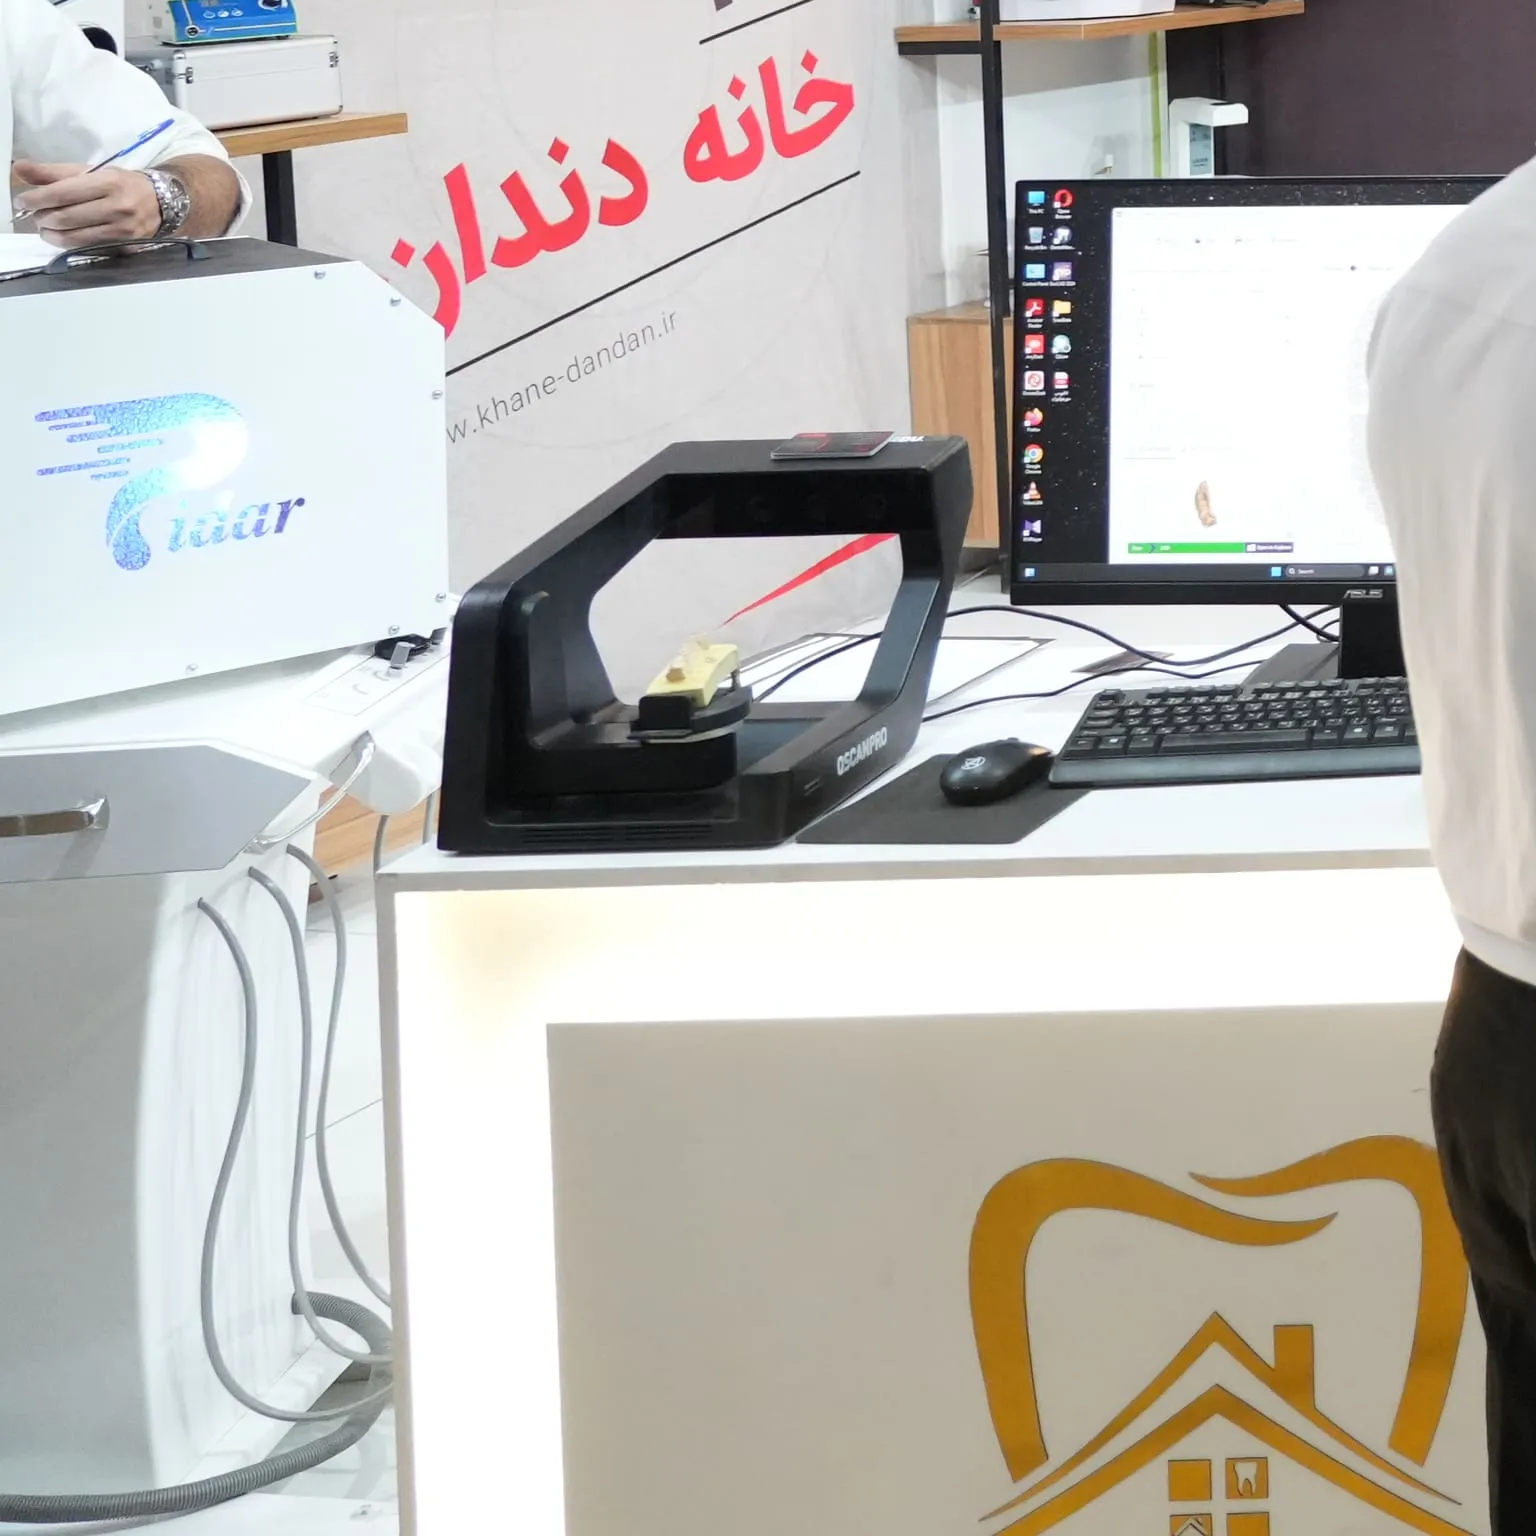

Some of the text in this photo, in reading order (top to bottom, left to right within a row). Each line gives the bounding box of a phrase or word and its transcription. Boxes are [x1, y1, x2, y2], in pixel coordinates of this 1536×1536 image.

[683, 49, 855, 184] خانه
[445, 310, 678, 445] w.khane-dandan.ir
[1343, 589, 1383, 600] ASUS
